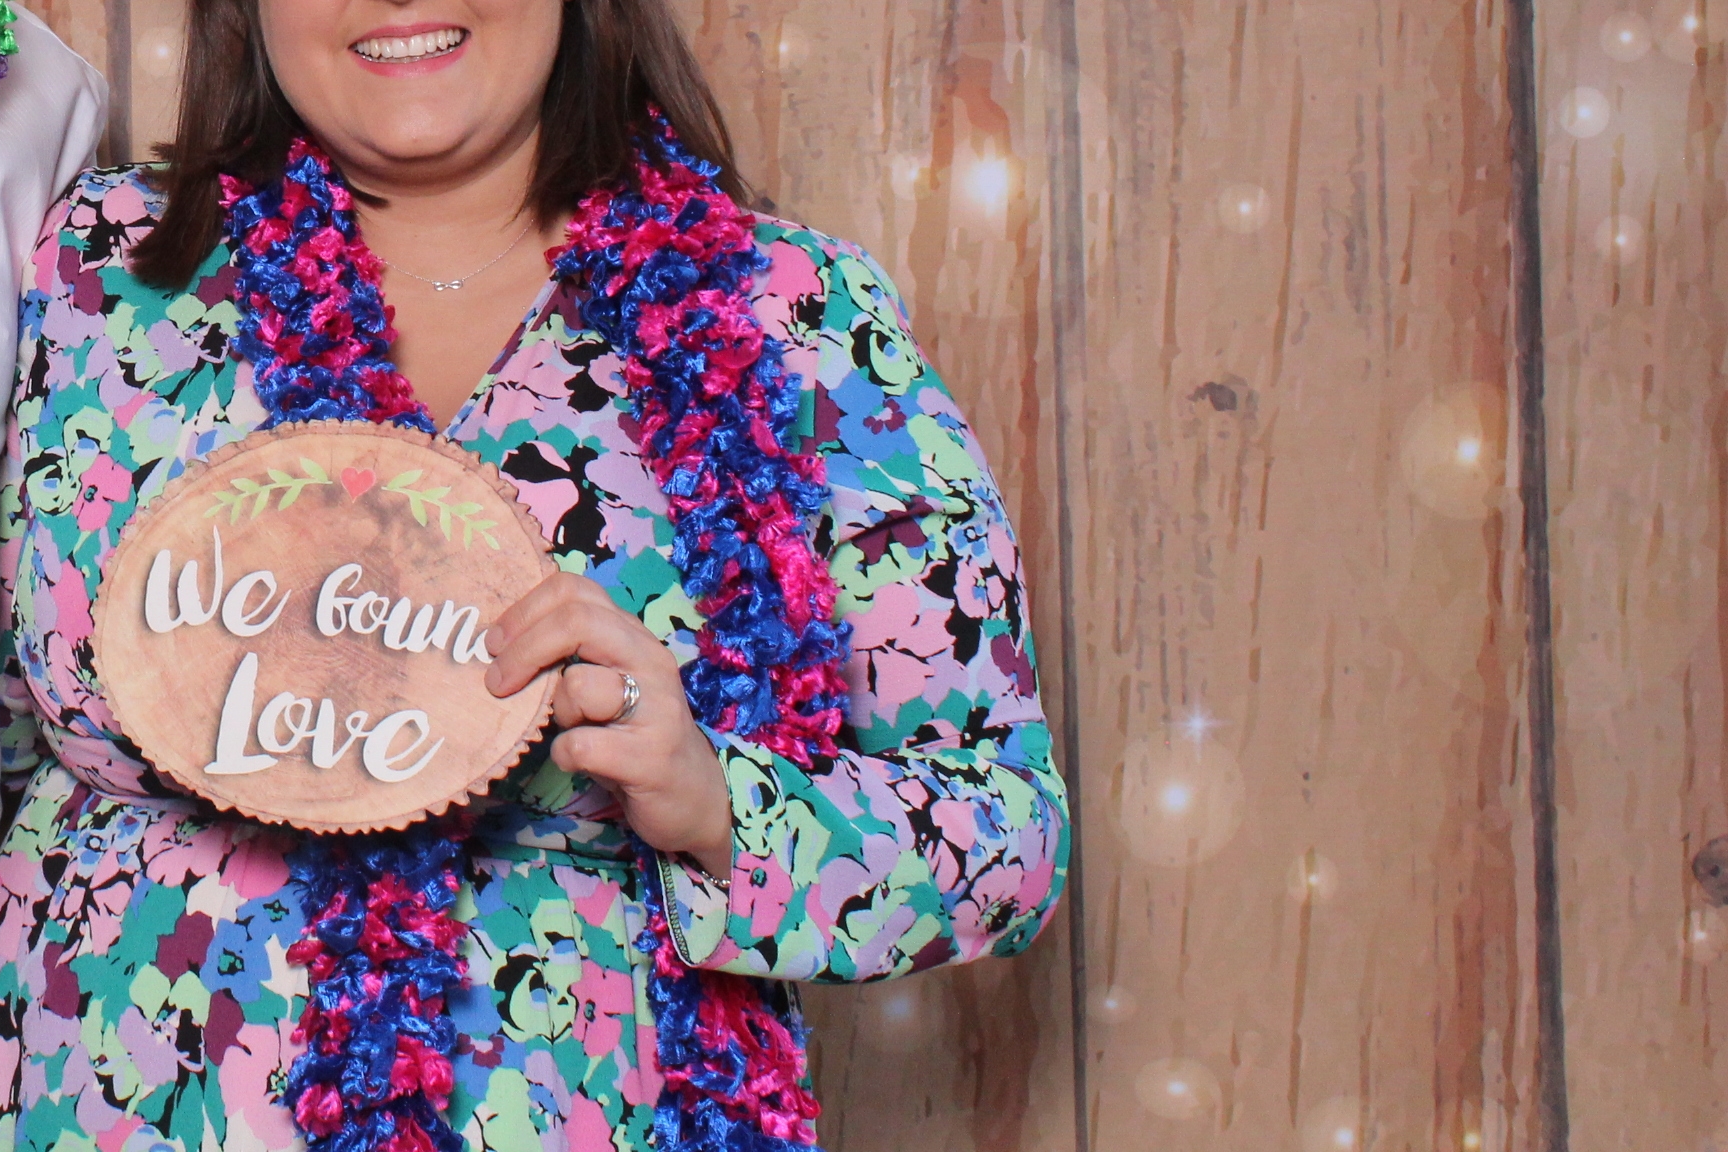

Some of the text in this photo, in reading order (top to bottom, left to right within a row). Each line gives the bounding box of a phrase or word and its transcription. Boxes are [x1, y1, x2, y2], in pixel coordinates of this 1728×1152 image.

[144, 525, 494, 665] We foun
[203, 651, 446, 783] Love
